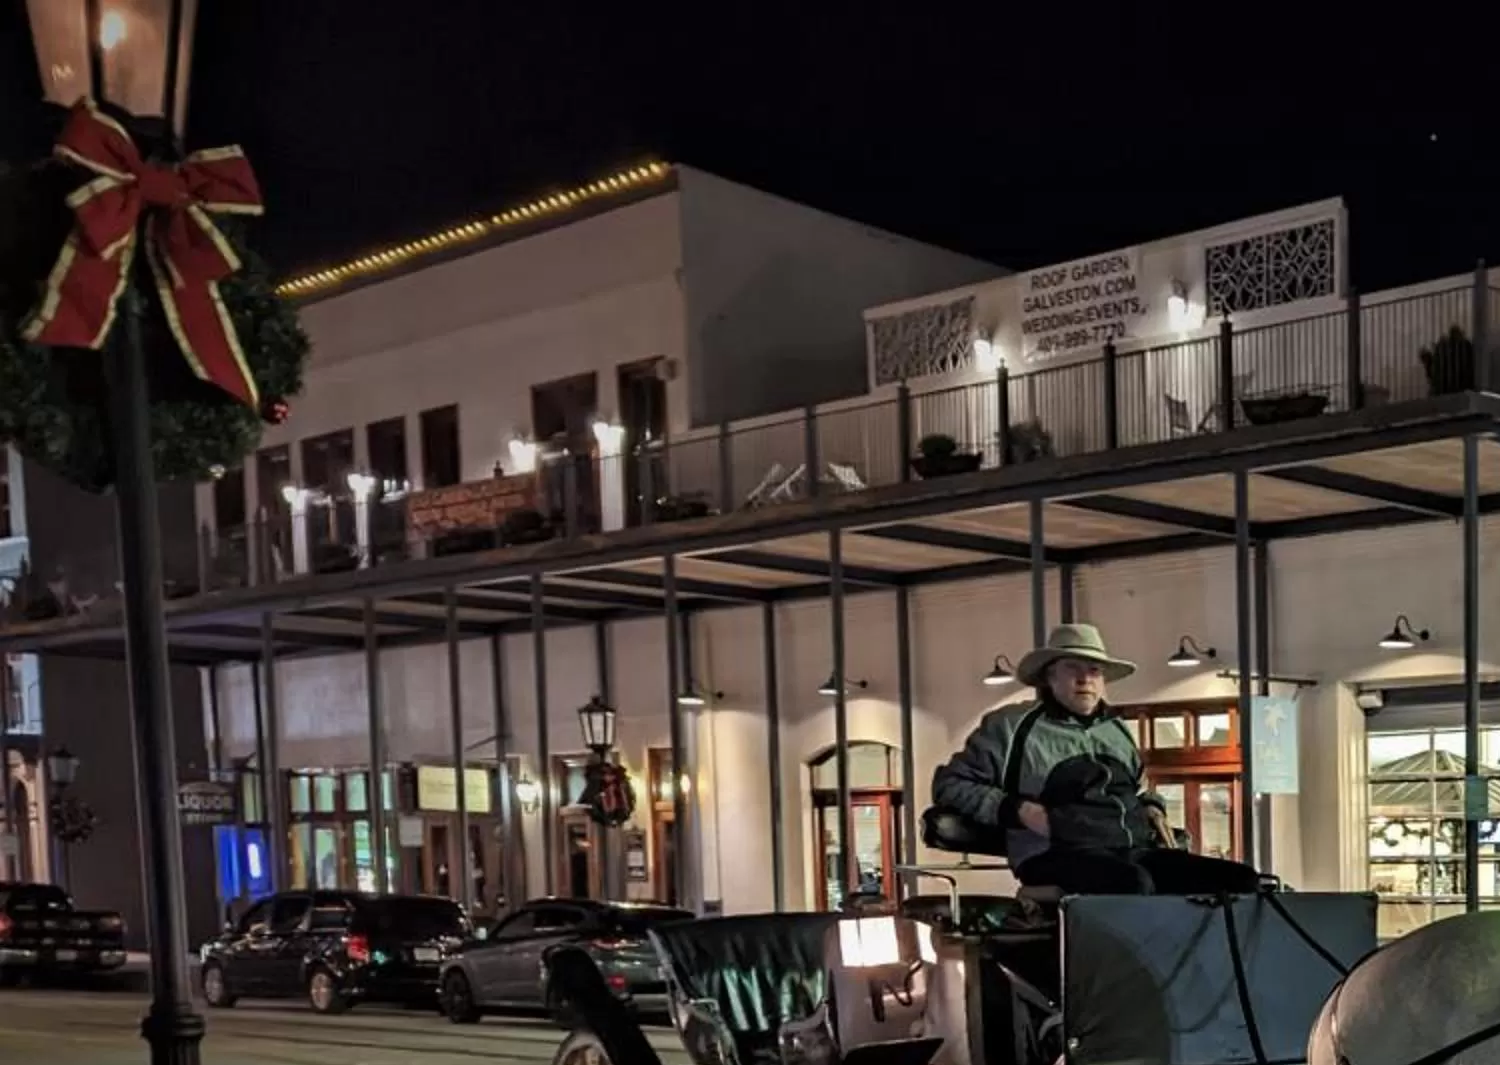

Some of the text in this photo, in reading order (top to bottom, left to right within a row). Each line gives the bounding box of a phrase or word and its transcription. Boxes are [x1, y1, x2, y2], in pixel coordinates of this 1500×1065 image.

[1031, 256, 1130, 290] ROOF GARDEN
[1021, 308, 1083, 334] WEDDING
[175, 794, 233, 810] LIQUOR
